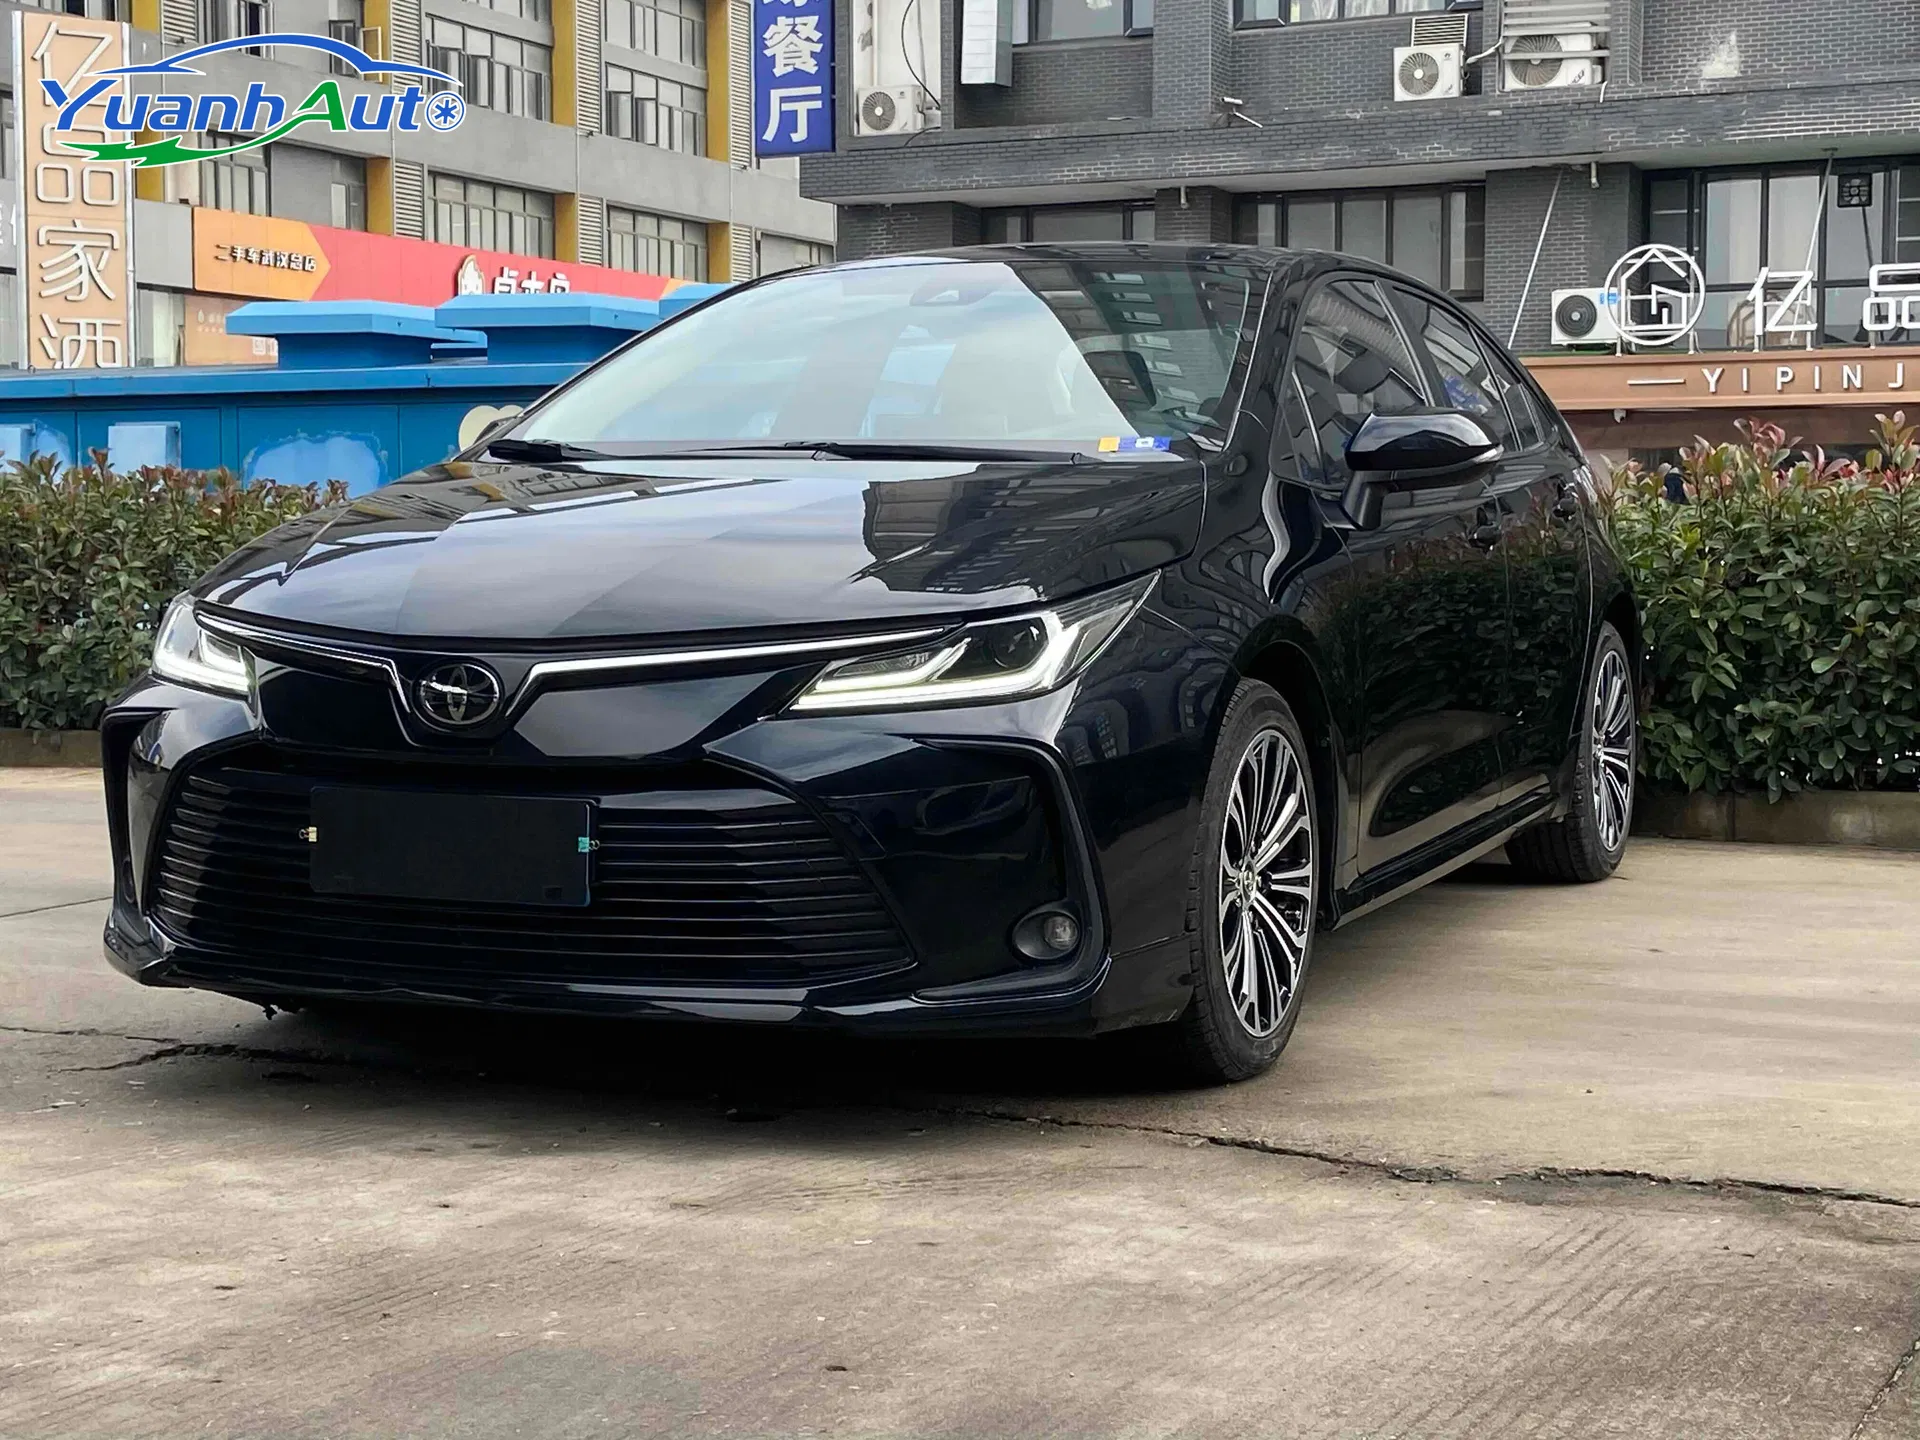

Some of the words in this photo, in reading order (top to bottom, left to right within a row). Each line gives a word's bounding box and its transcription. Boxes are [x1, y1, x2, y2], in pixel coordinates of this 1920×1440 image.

[761, 0, 824, 143] 餐厅
[214, 244, 317, 273] 二手车武汉总店
